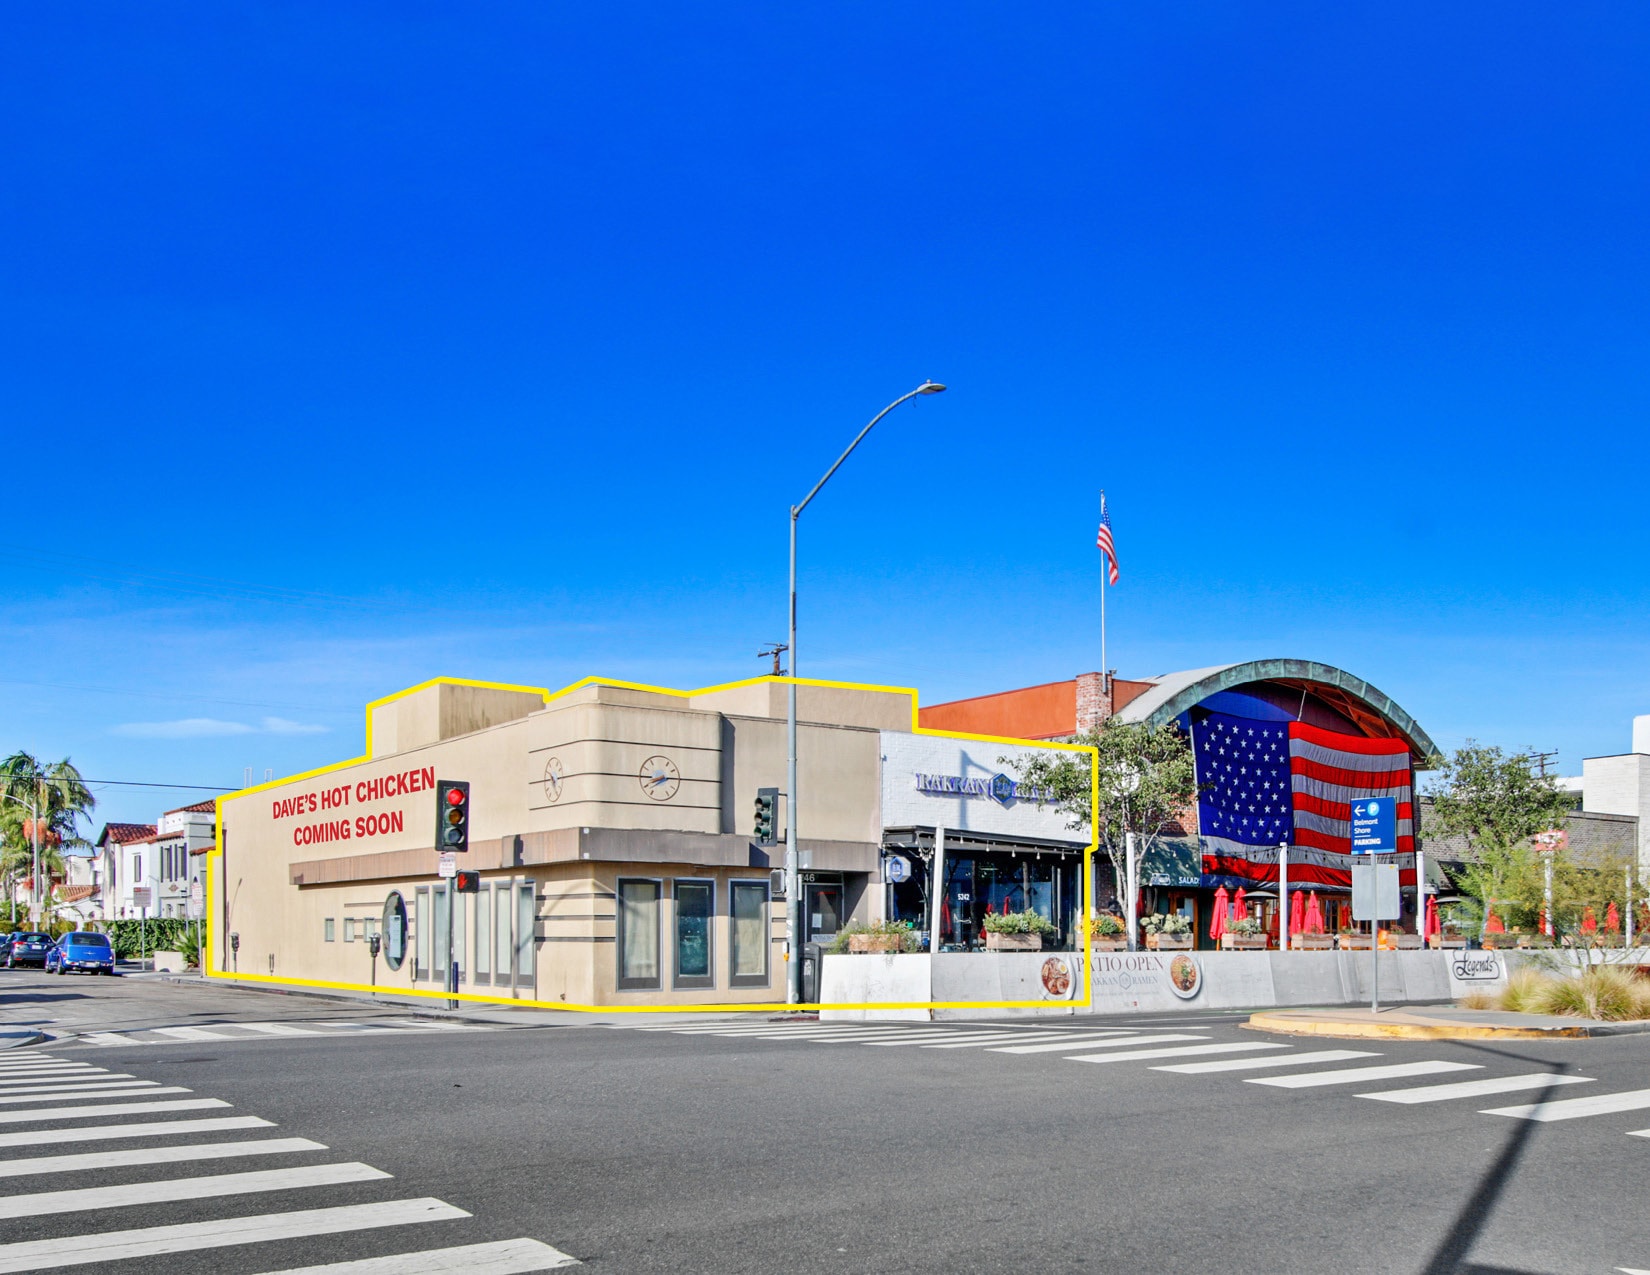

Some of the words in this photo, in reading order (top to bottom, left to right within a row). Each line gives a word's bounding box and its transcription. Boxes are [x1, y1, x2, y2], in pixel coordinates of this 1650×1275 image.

[272, 793, 317, 819] DAVE'S
[321, 785, 351, 810] HOT
[356, 766, 435, 803] CHICKEN
[293, 819, 350, 846] COMING
[355, 810, 403, 838] SOON
[1354, 818, 1379, 826] Belmont
[1354, 838, 1381, 846] PARKING
[1125, 956, 1163, 971] OPEN
[1456, 951, 1493, 977] Legends
